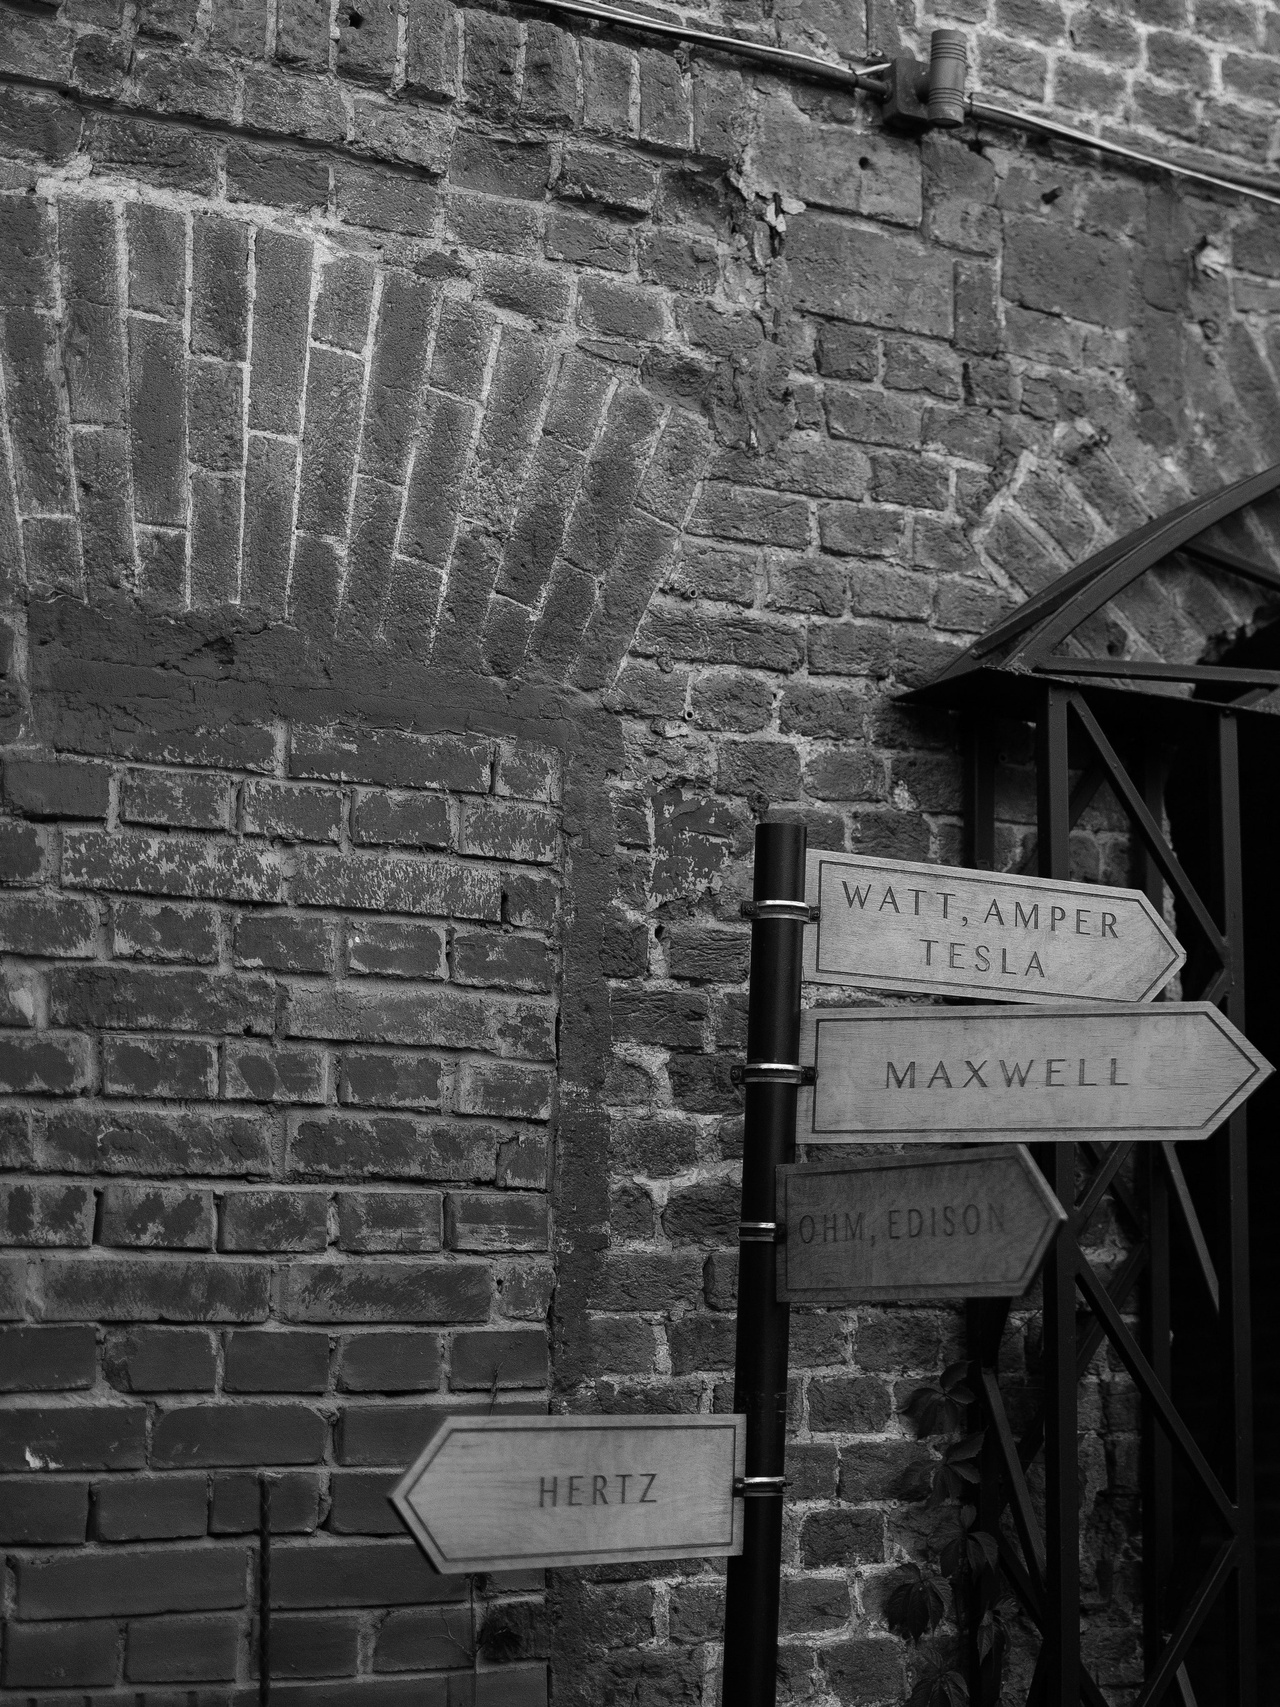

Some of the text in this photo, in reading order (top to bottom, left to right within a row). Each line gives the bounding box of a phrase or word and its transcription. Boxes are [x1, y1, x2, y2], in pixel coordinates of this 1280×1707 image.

[983, 898, 1120, 939] AMPER
[918, 938, 1046, 978] TESLA
[885, 1057, 1130, 1089] MAXWELL
[887, 1202, 1006, 1240] EDISON
[538, 1472, 658, 1508] HERTZ
